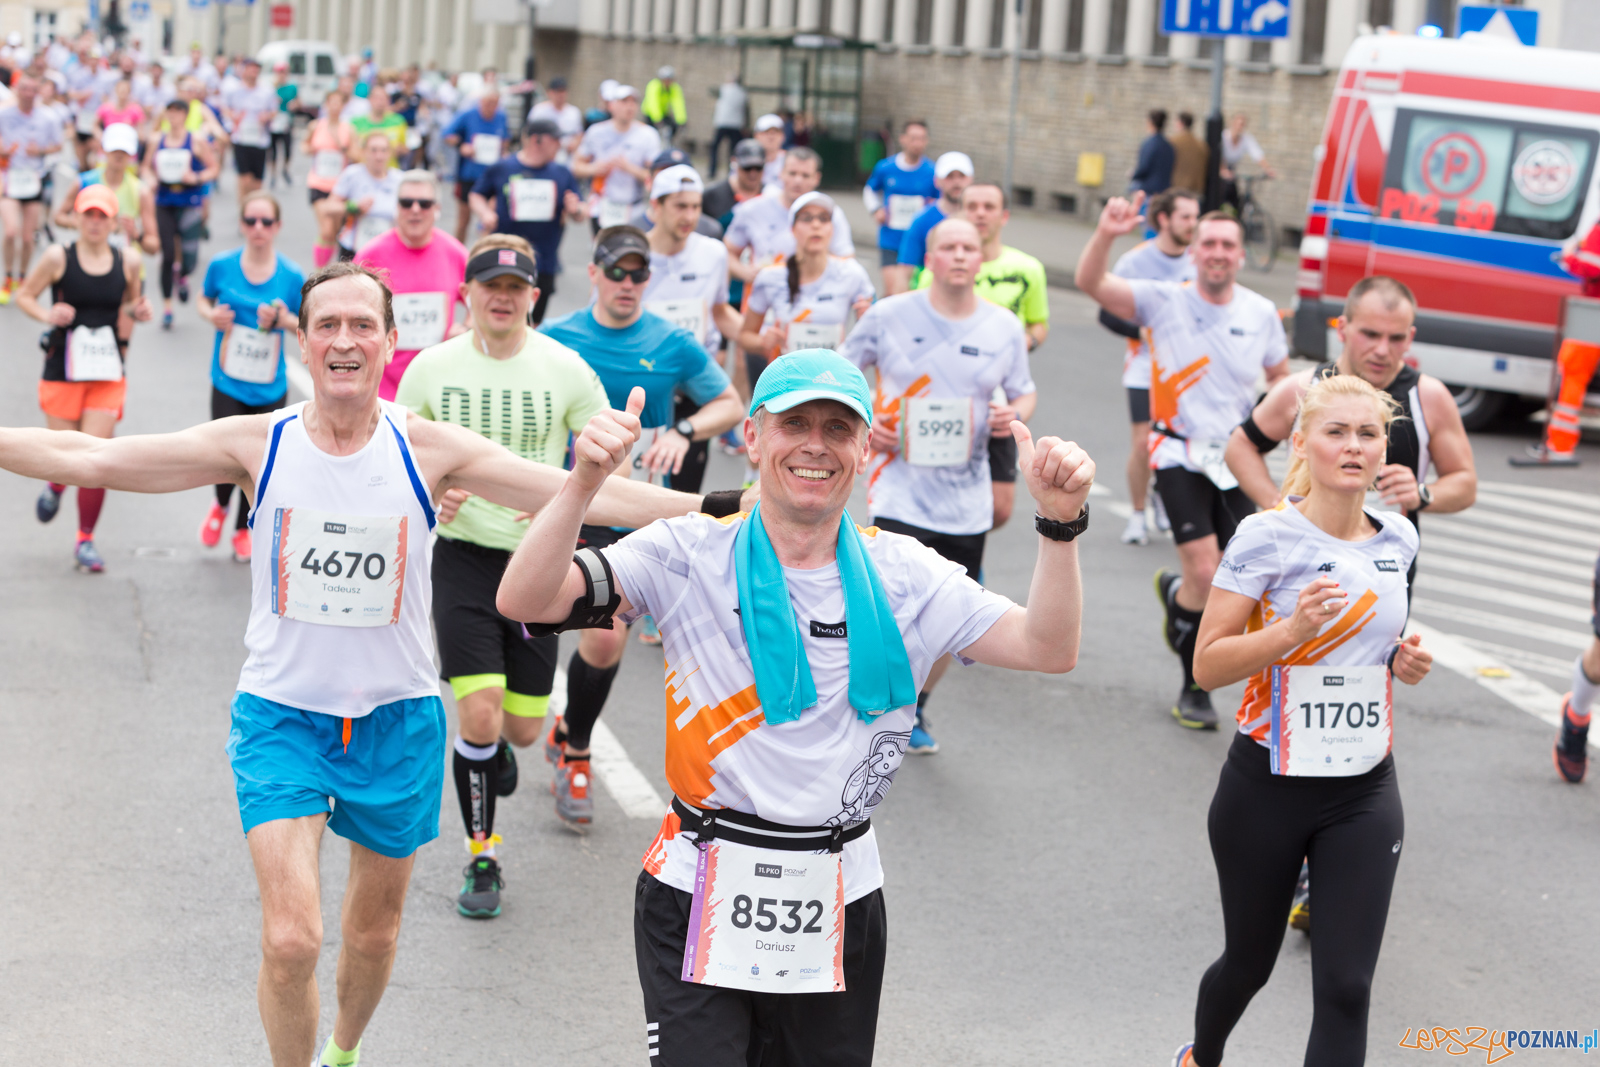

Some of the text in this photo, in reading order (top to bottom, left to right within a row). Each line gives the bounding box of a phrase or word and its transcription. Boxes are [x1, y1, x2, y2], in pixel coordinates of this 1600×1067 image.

[918, 420, 964, 437] 5992
[301, 547, 386, 580] 4670
[322, 582, 361, 595] Tadeusz
[1299, 701, 1381, 729] 11705
[1321, 735, 1364, 746] Agnieszka
[731, 894, 824, 935] 8532
[755, 939, 796, 952] Dariusz
